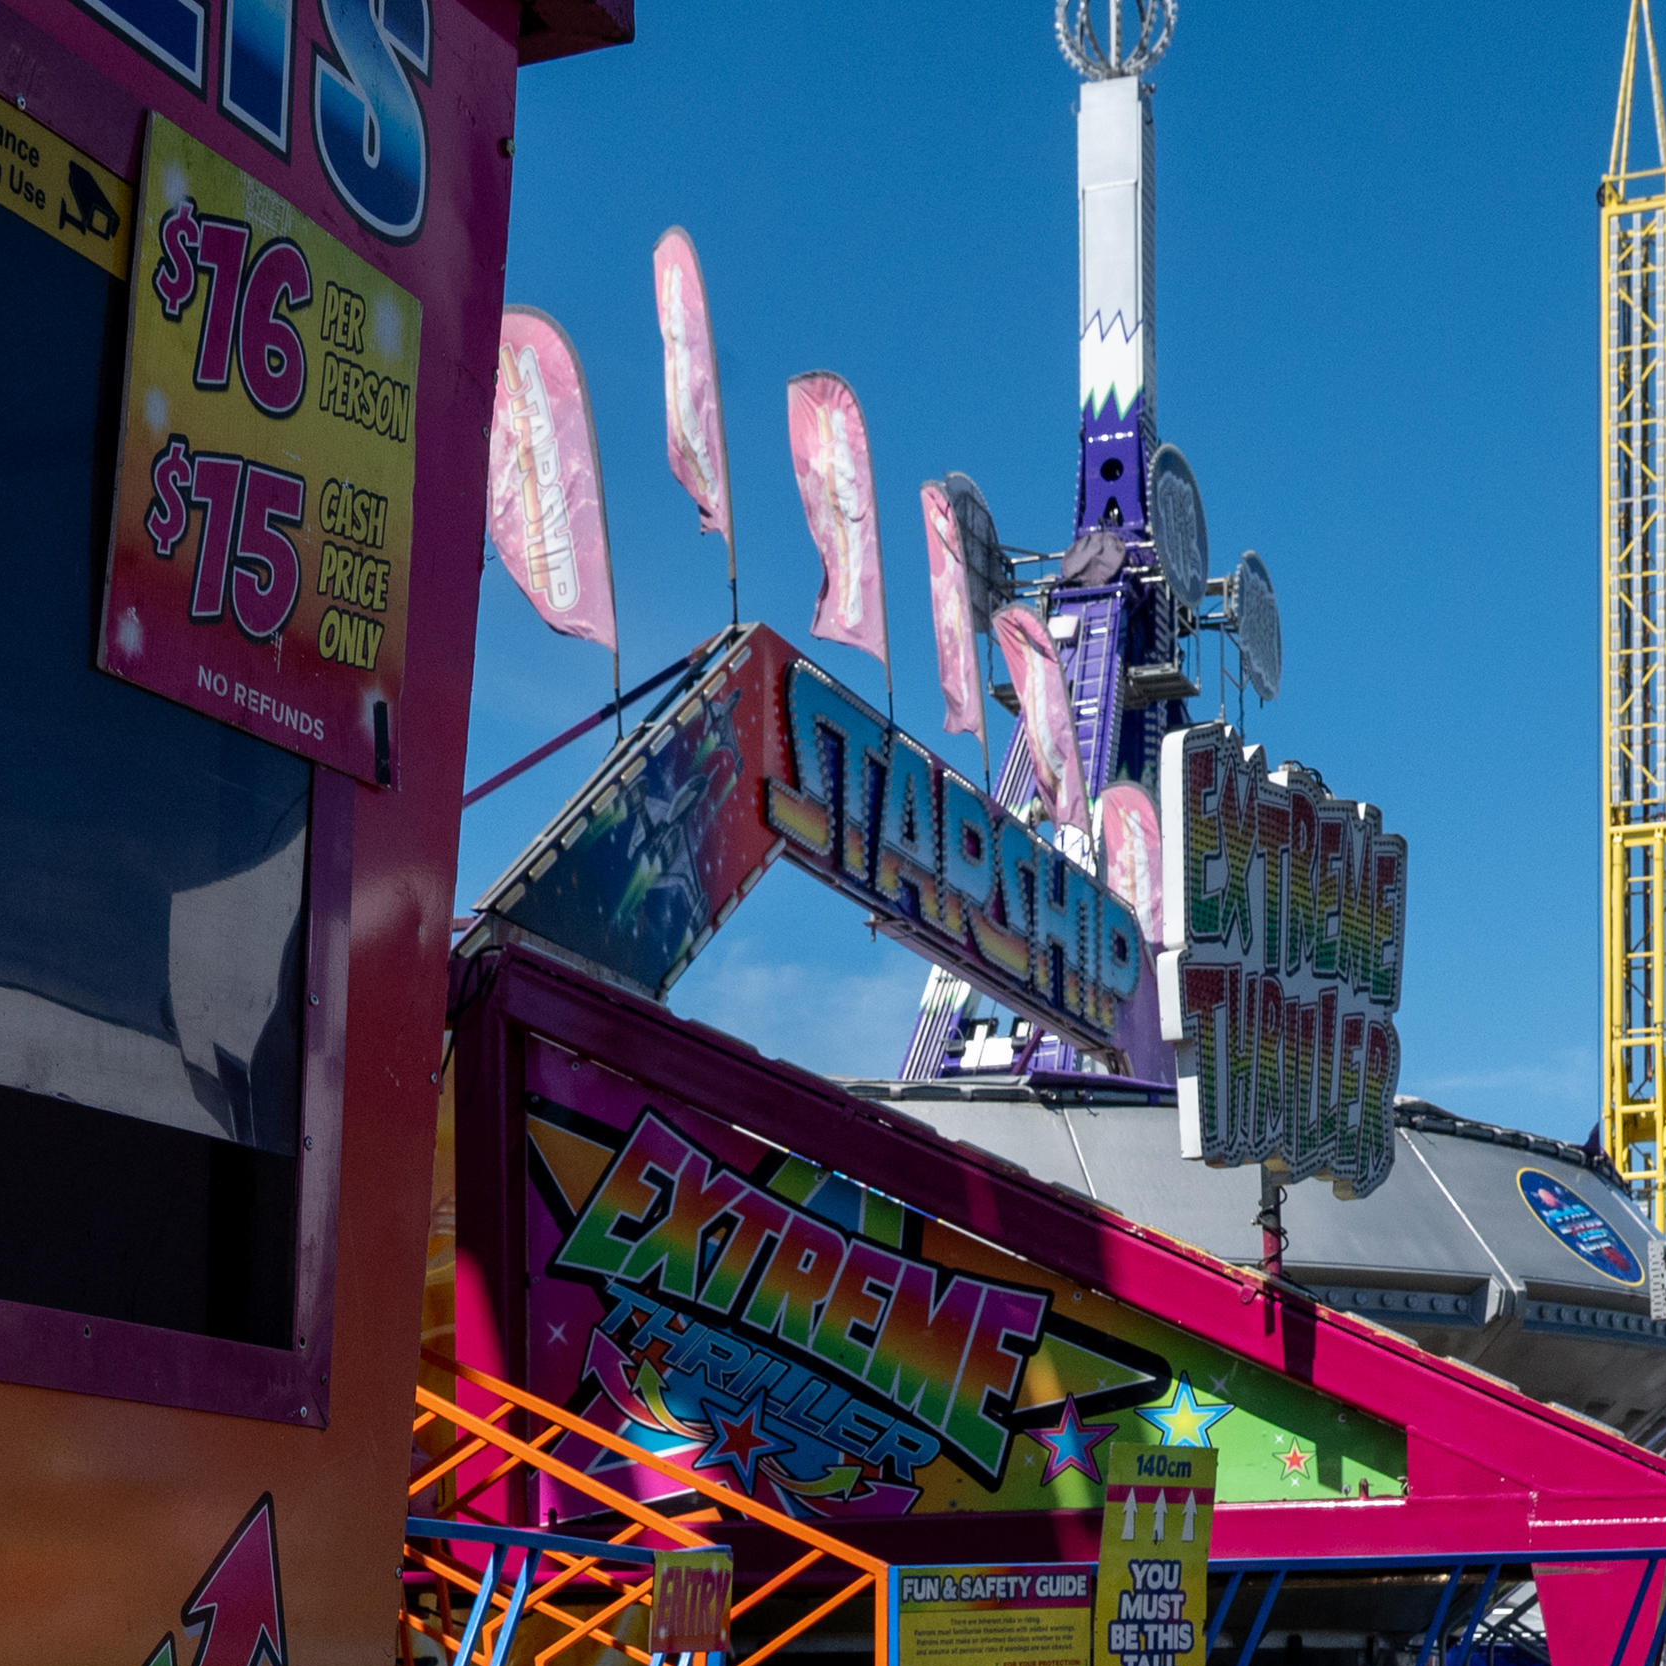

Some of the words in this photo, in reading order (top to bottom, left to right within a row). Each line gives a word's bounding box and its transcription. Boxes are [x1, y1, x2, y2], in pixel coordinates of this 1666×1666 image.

[8, 163, 47, 211] Use
[153, 202, 313, 417] $16
[320, 281, 366, 354] PER
[319, 354, 411, 442] PERSON
[318, 477, 388, 550] CASH
[499, 343, 583, 614] STARSHIP
[147, 442, 305, 640] $15
[317, 541, 391, 613] PRICE
[317, 605, 385, 671] ONLY
[197, 665, 228, 698] NO
[234, 681, 325, 742] REFUNDS
[767, 659, 1141, 1037] STARSHIP
[1185, 745, 1398, 998] EXTREME
[1183, 962, 1393, 1167] THRILLER
[553, 1110, 1051, 1480] EXTREME
[598, 1282, 943, 1483] THRILLER
[1136, 1453, 1192, 1478] 140cm
[654, 1566, 732, 1637] ENTRY
[902, 1577, 940, 1601] FUN
[942, 1575, 958, 1600] &
[960, 1575, 1032, 1599] SAFETY
[1034, 1574, 1088, 1597] GUIDE
[1120, 1593, 1184, 1620] MUST
[1130, 1561, 1180, 1590] YOU
[1110, 1623, 1139, 1651] BE
[1142, 1623, 1193, 1651] THIS
